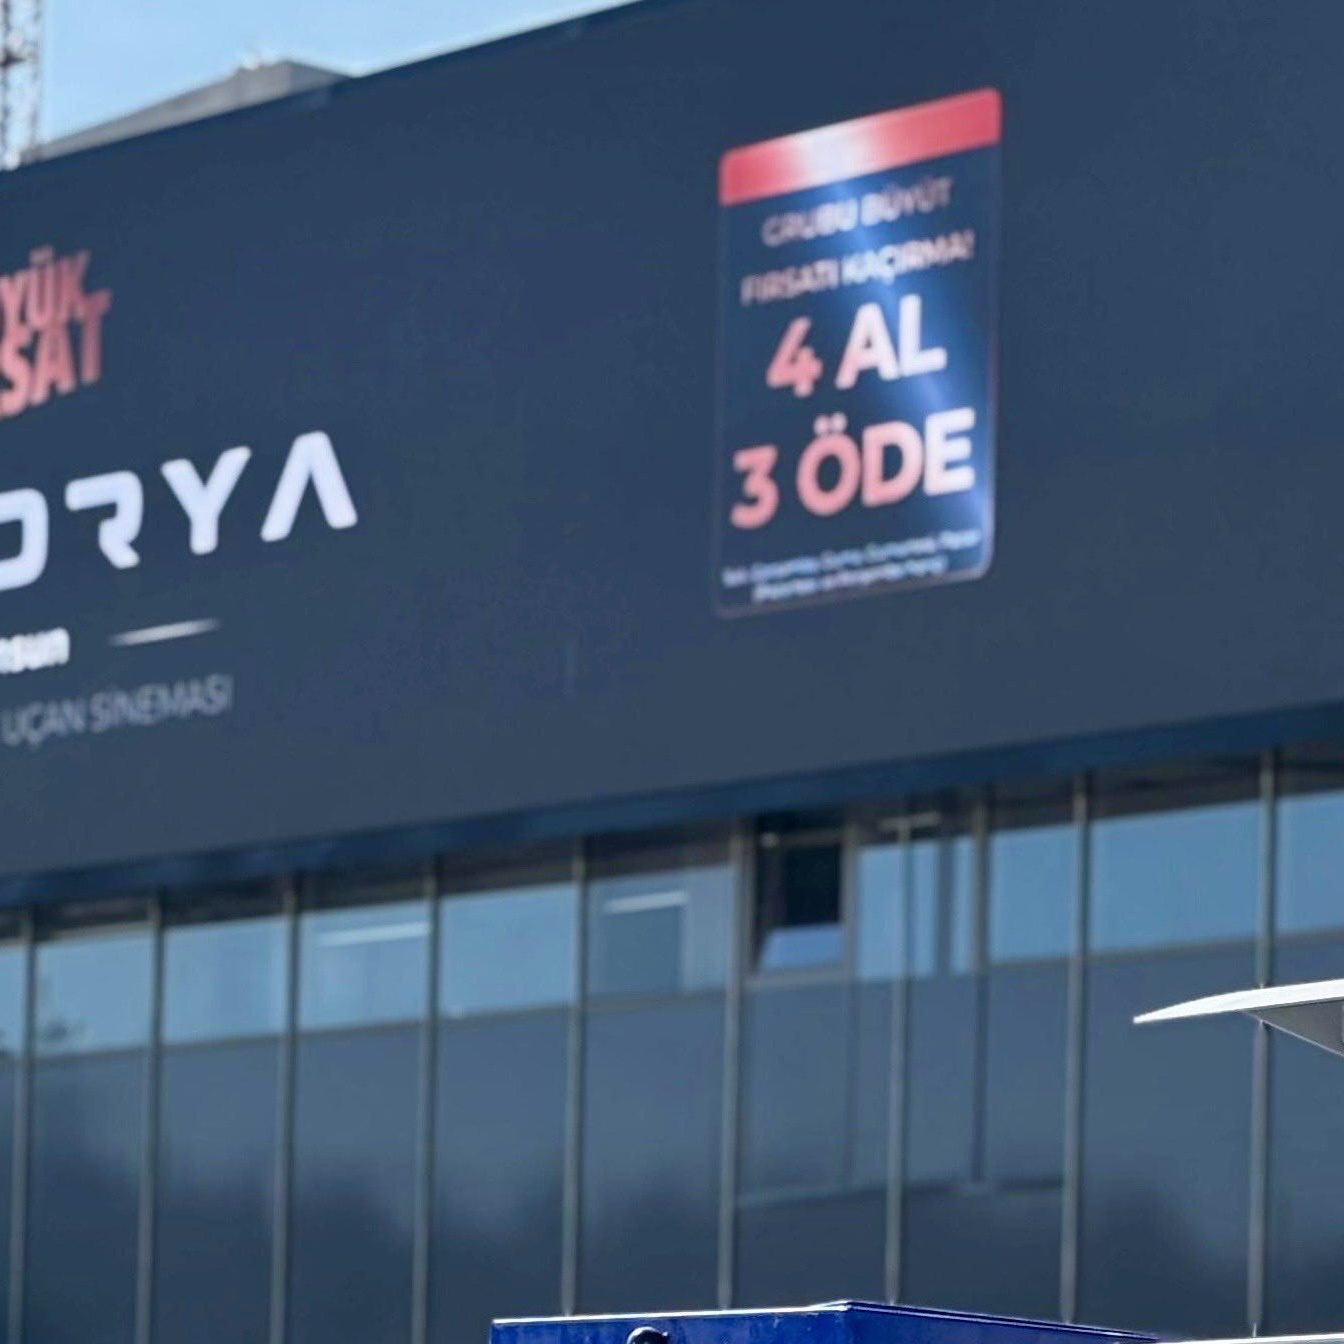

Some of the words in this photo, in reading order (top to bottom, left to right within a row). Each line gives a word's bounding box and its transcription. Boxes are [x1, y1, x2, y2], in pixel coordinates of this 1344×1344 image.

[766, 316, 822, 397] 4
[835, 293, 947, 389] AL
[730, 444, 779, 529] 3
[797, 406, 976, 516] ÖDE
